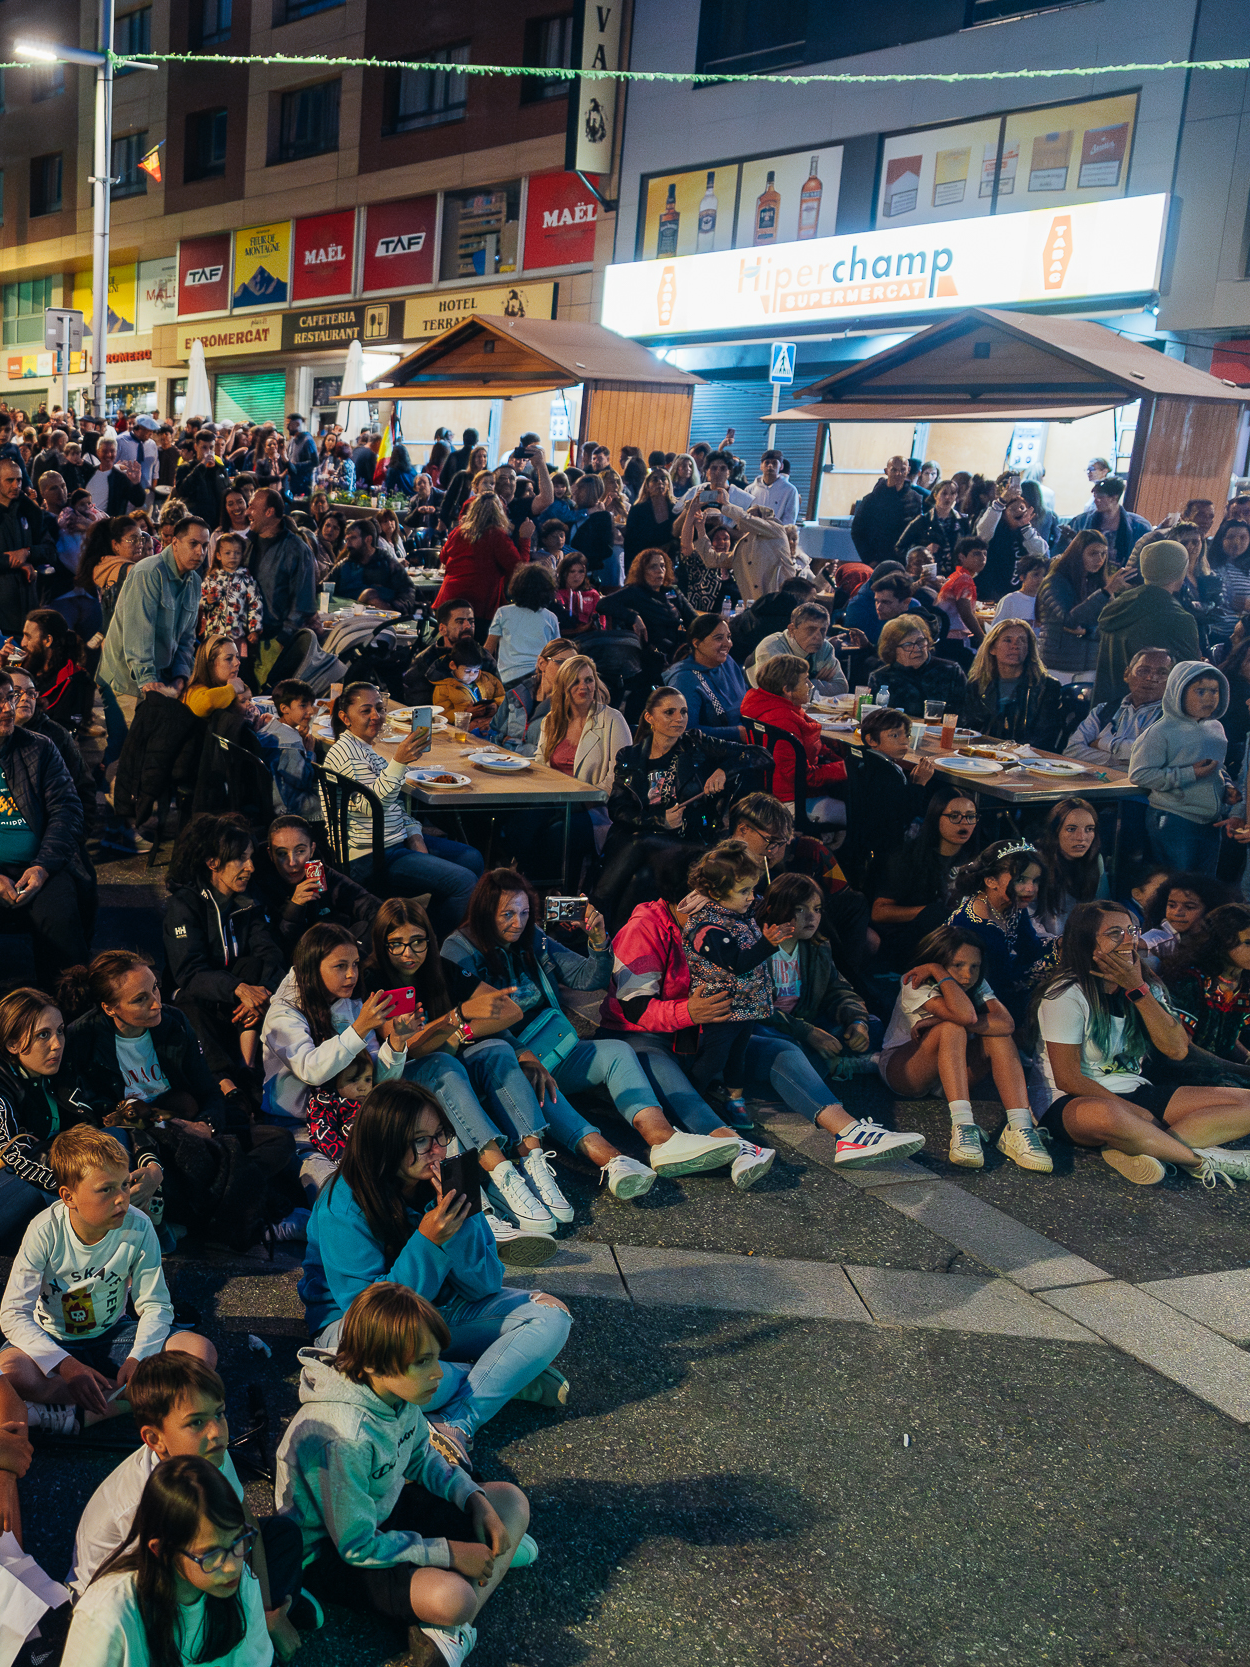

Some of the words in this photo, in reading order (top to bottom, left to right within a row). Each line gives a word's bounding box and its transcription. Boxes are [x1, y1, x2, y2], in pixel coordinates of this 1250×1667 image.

[542, 202, 597, 228] MAËL
[304, 243, 345, 266] MAËL
[380, 235, 423, 254] TAF
[189, 267, 221, 283] TAF
[738, 245, 953, 314] Hiperchamp
[439, 298, 478, 312] HOTEL
[785, 281, 923, 309] SUPERMERCAT
[299, 311, 356, 328] CAFETERIA
[185, 327, 270, 350] EROMERCAT
[294, 327, 361, 345] RESTAURANT
